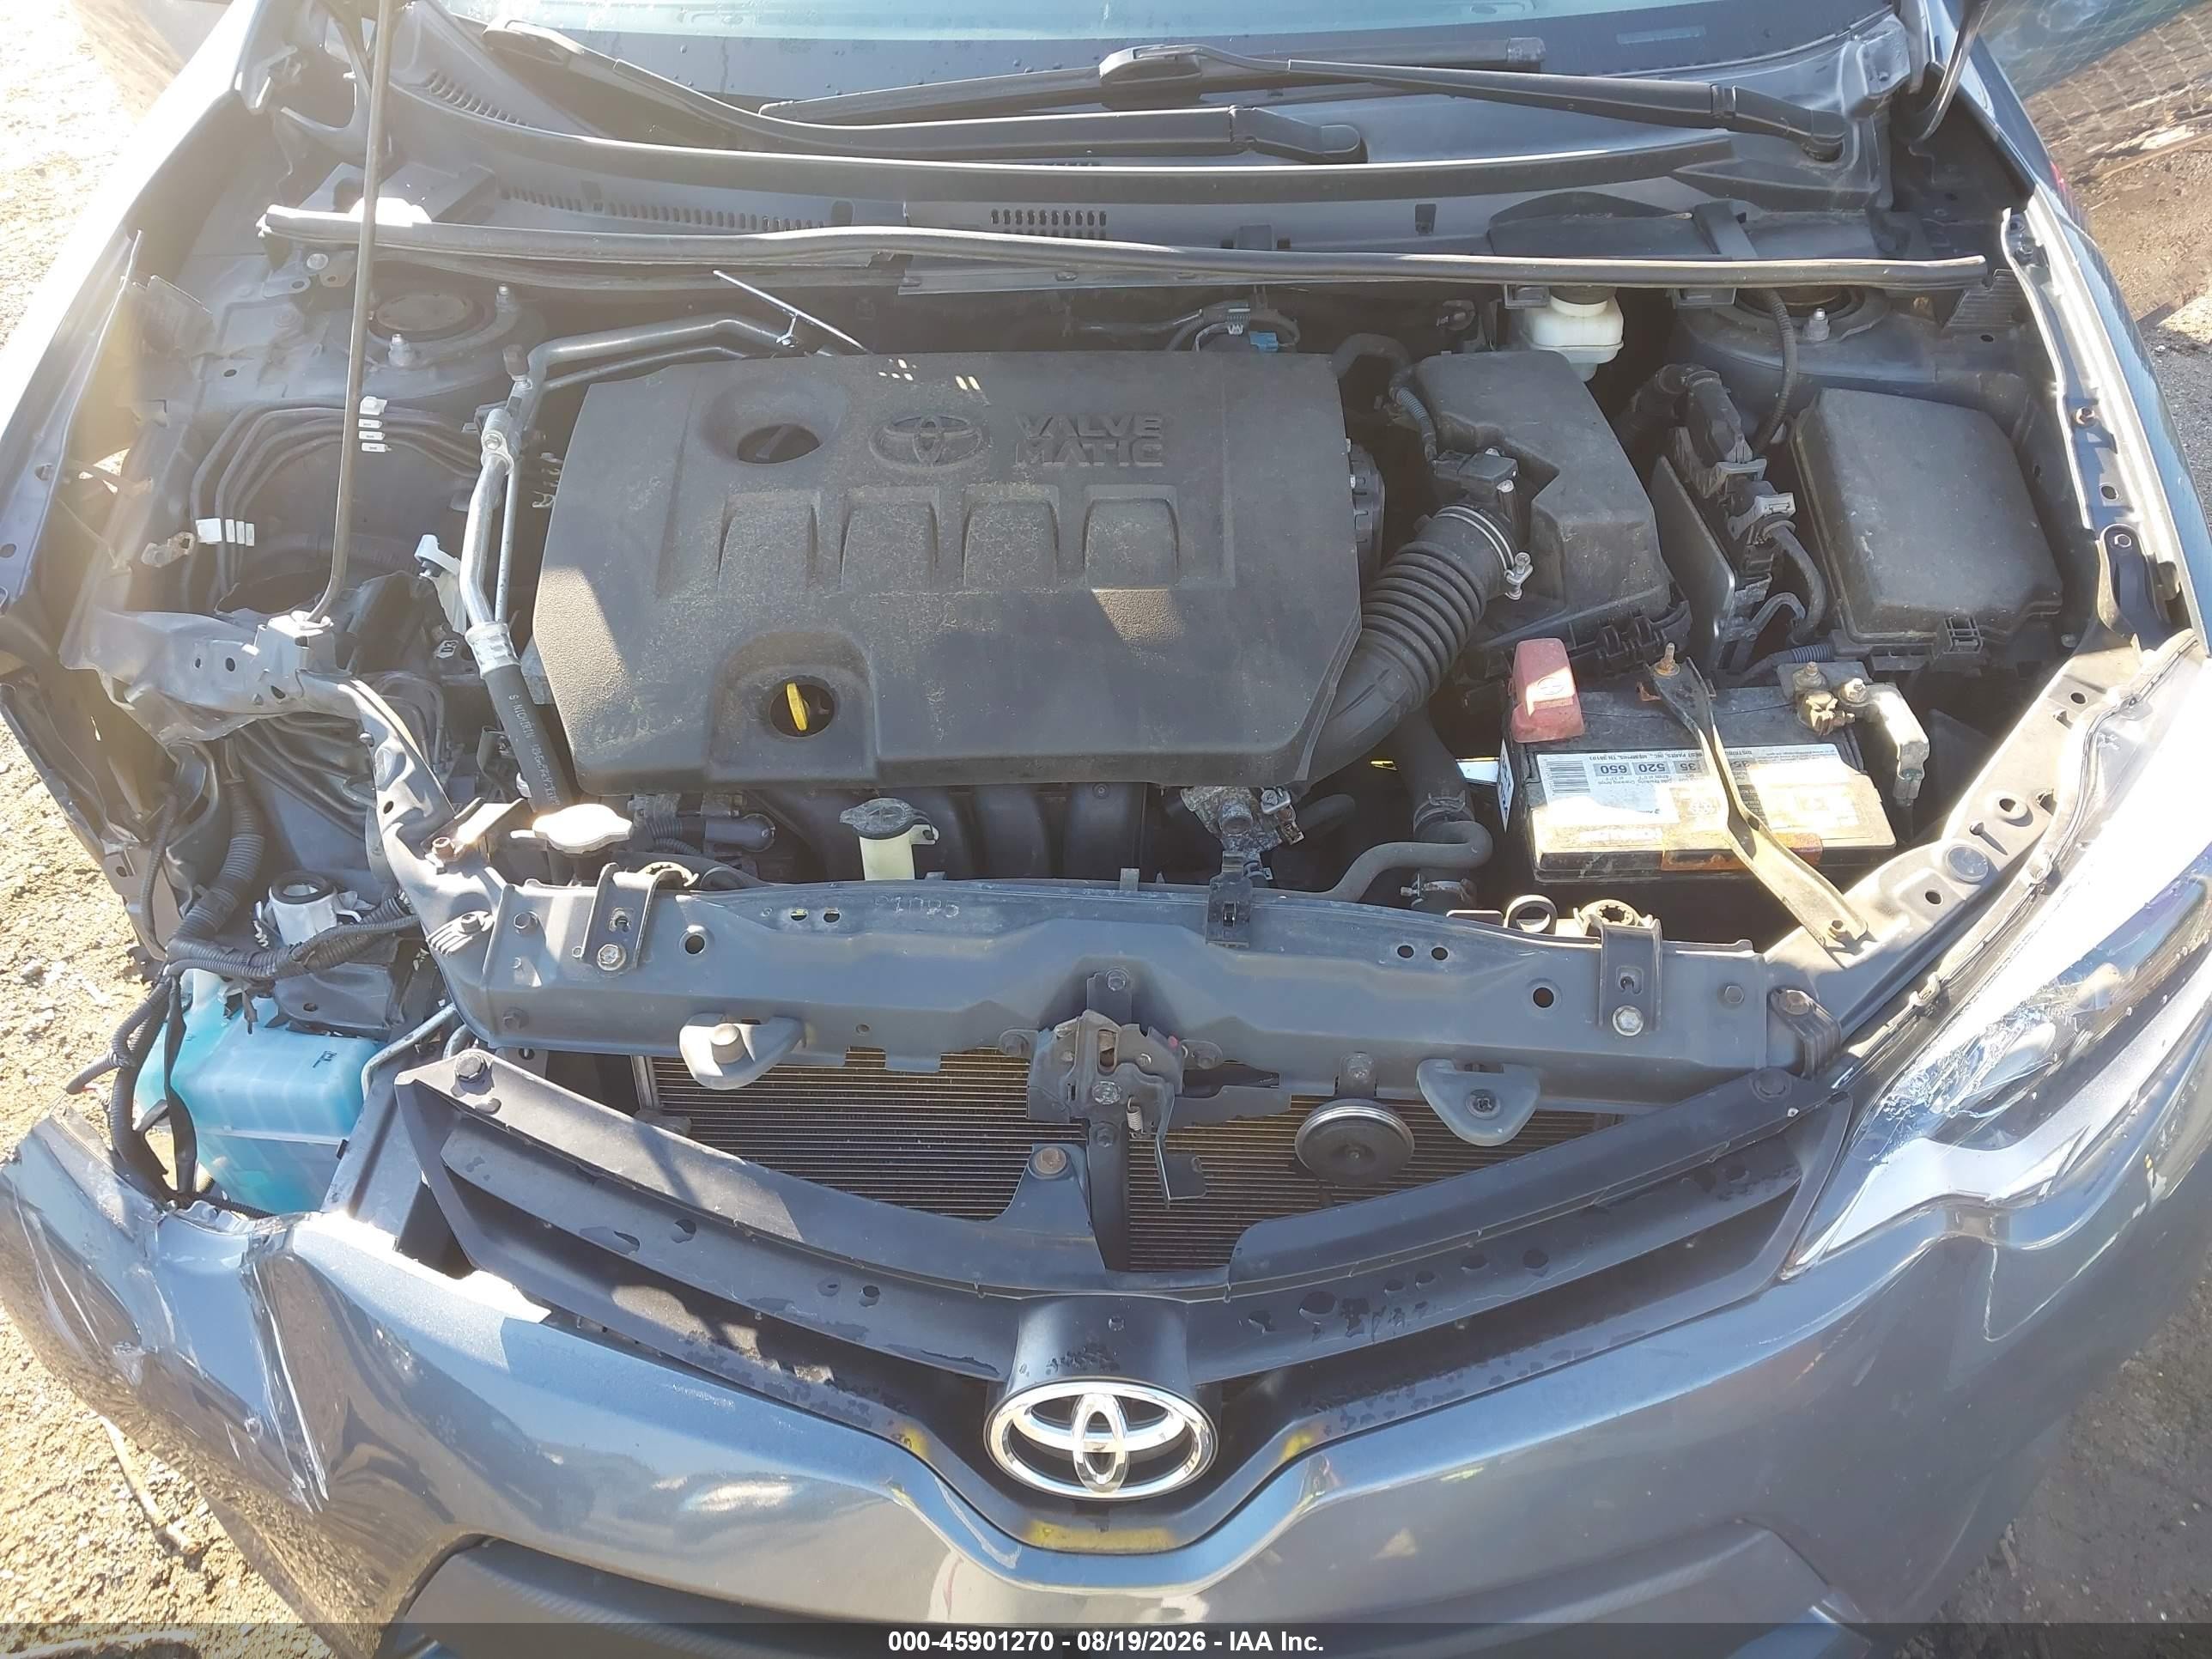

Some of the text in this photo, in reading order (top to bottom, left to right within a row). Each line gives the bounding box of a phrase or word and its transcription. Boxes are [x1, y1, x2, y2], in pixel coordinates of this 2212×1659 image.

[1015, 413, 1163, 440] VALVE
[1014, 440, 1164, 466] MATIC
[1600, 764, 1628, 774] 650
[1638, 763, 1666, 773] 520
[1680, 763, 1697, 771] 35
